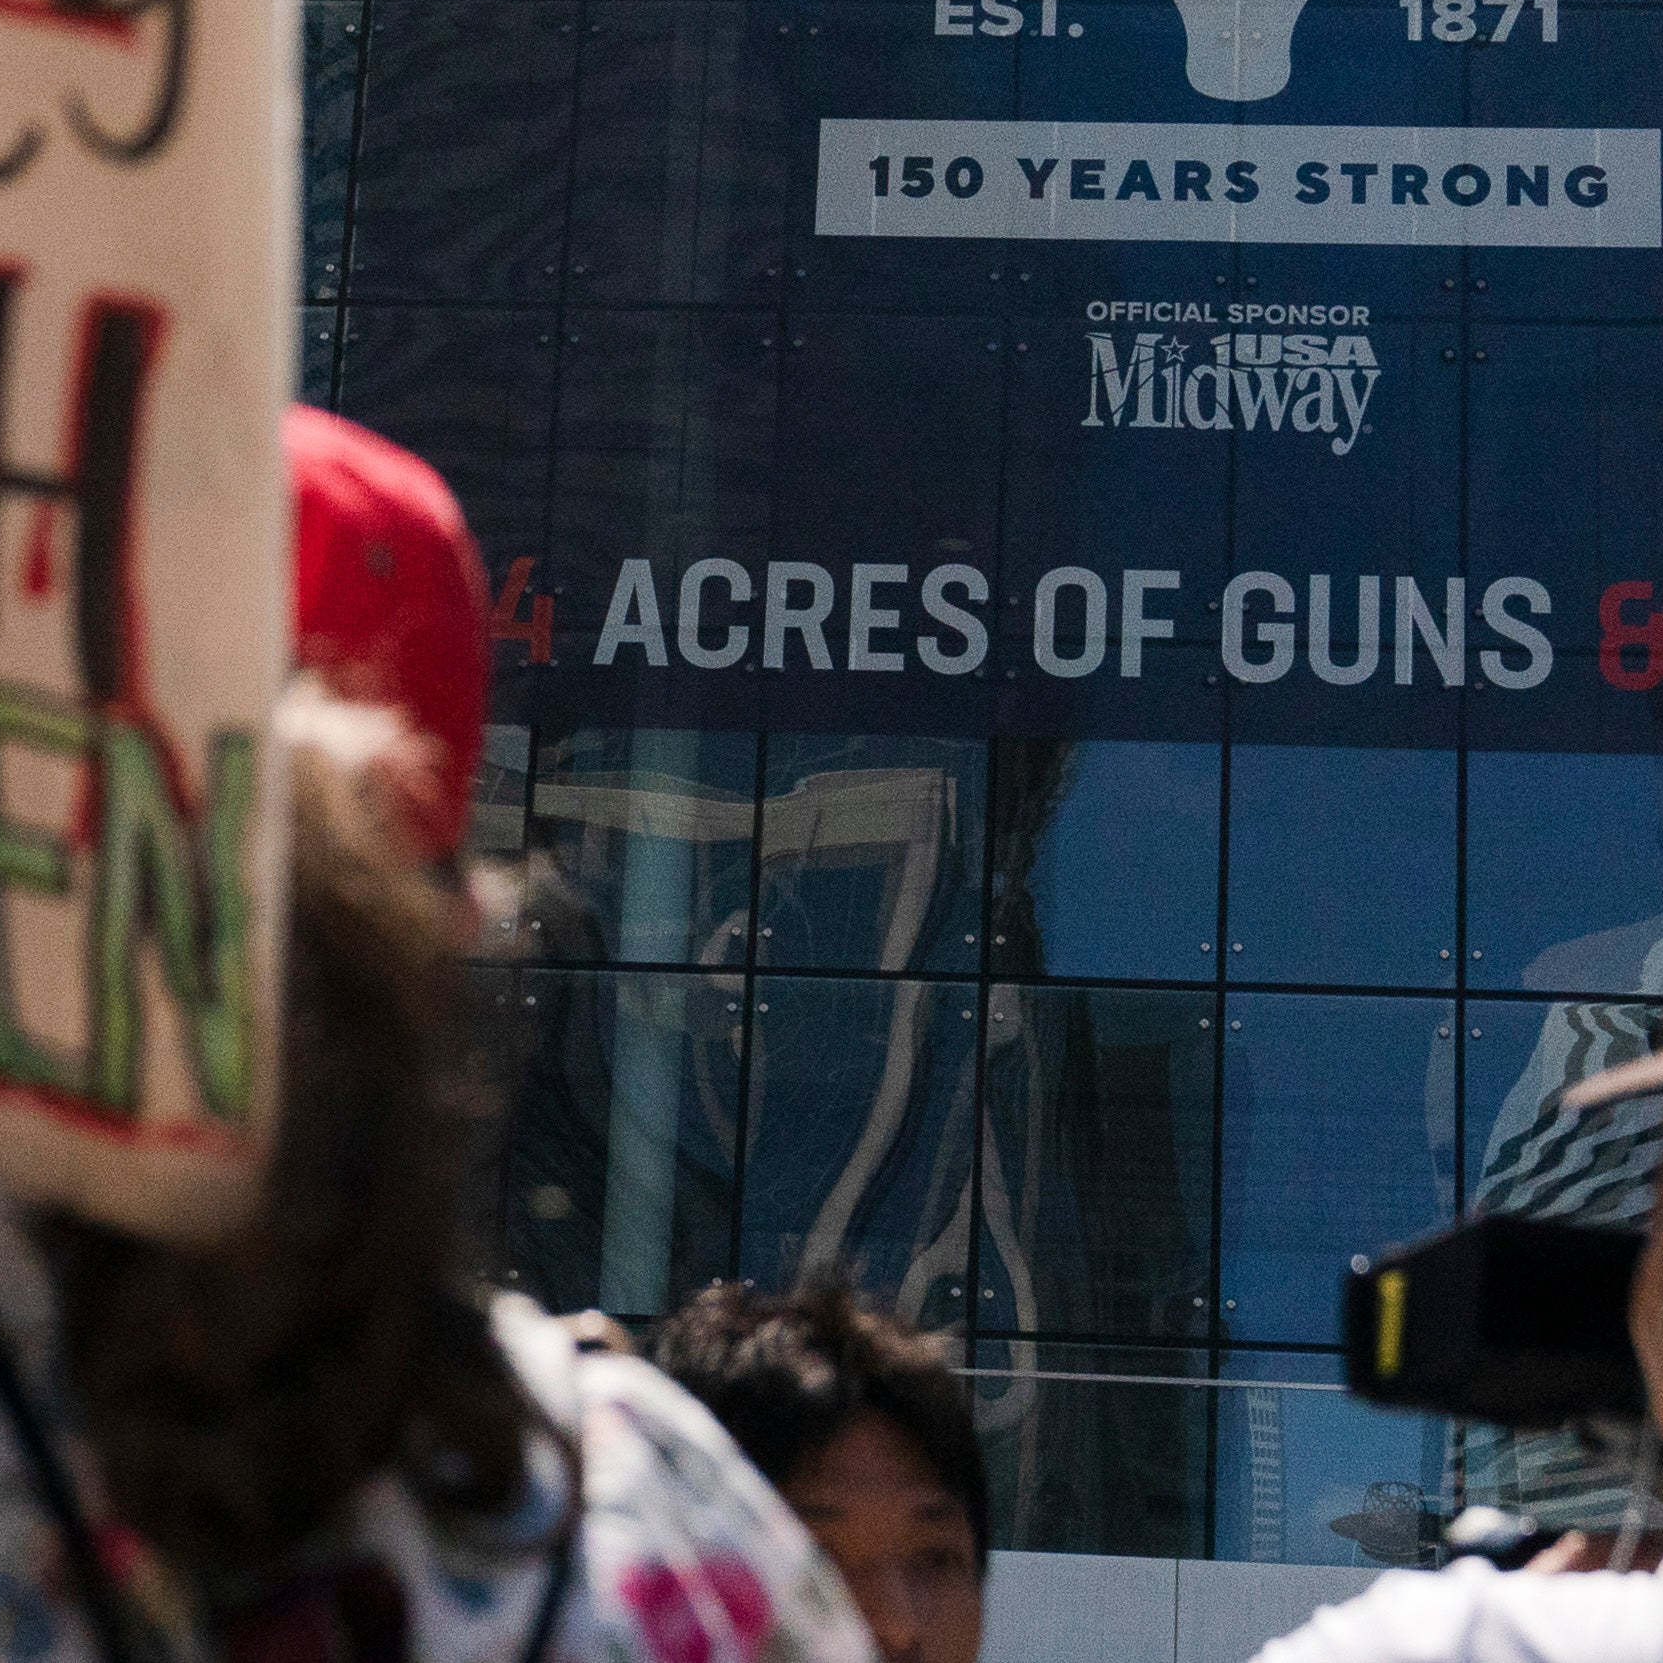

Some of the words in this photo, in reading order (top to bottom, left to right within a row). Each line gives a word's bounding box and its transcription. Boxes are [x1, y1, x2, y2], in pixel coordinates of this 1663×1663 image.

[867, 155, 985, 200] 150
[1015, 157, 1261, 204] YEARS
[1294, 161, 1611, 209] STRONG
[1086, 300, 1218, 324] OFFICIAL
[1227, 303, 1370, 327] SPONSOR
[1235, 333, 1378, 367] USA
[1081, 332, 1382, 456] Midway
[591, 557, 990, 677] ACRES
[1032, 565, 1182, 680] OF
[1220, 570, 1555, 691] GUNS
